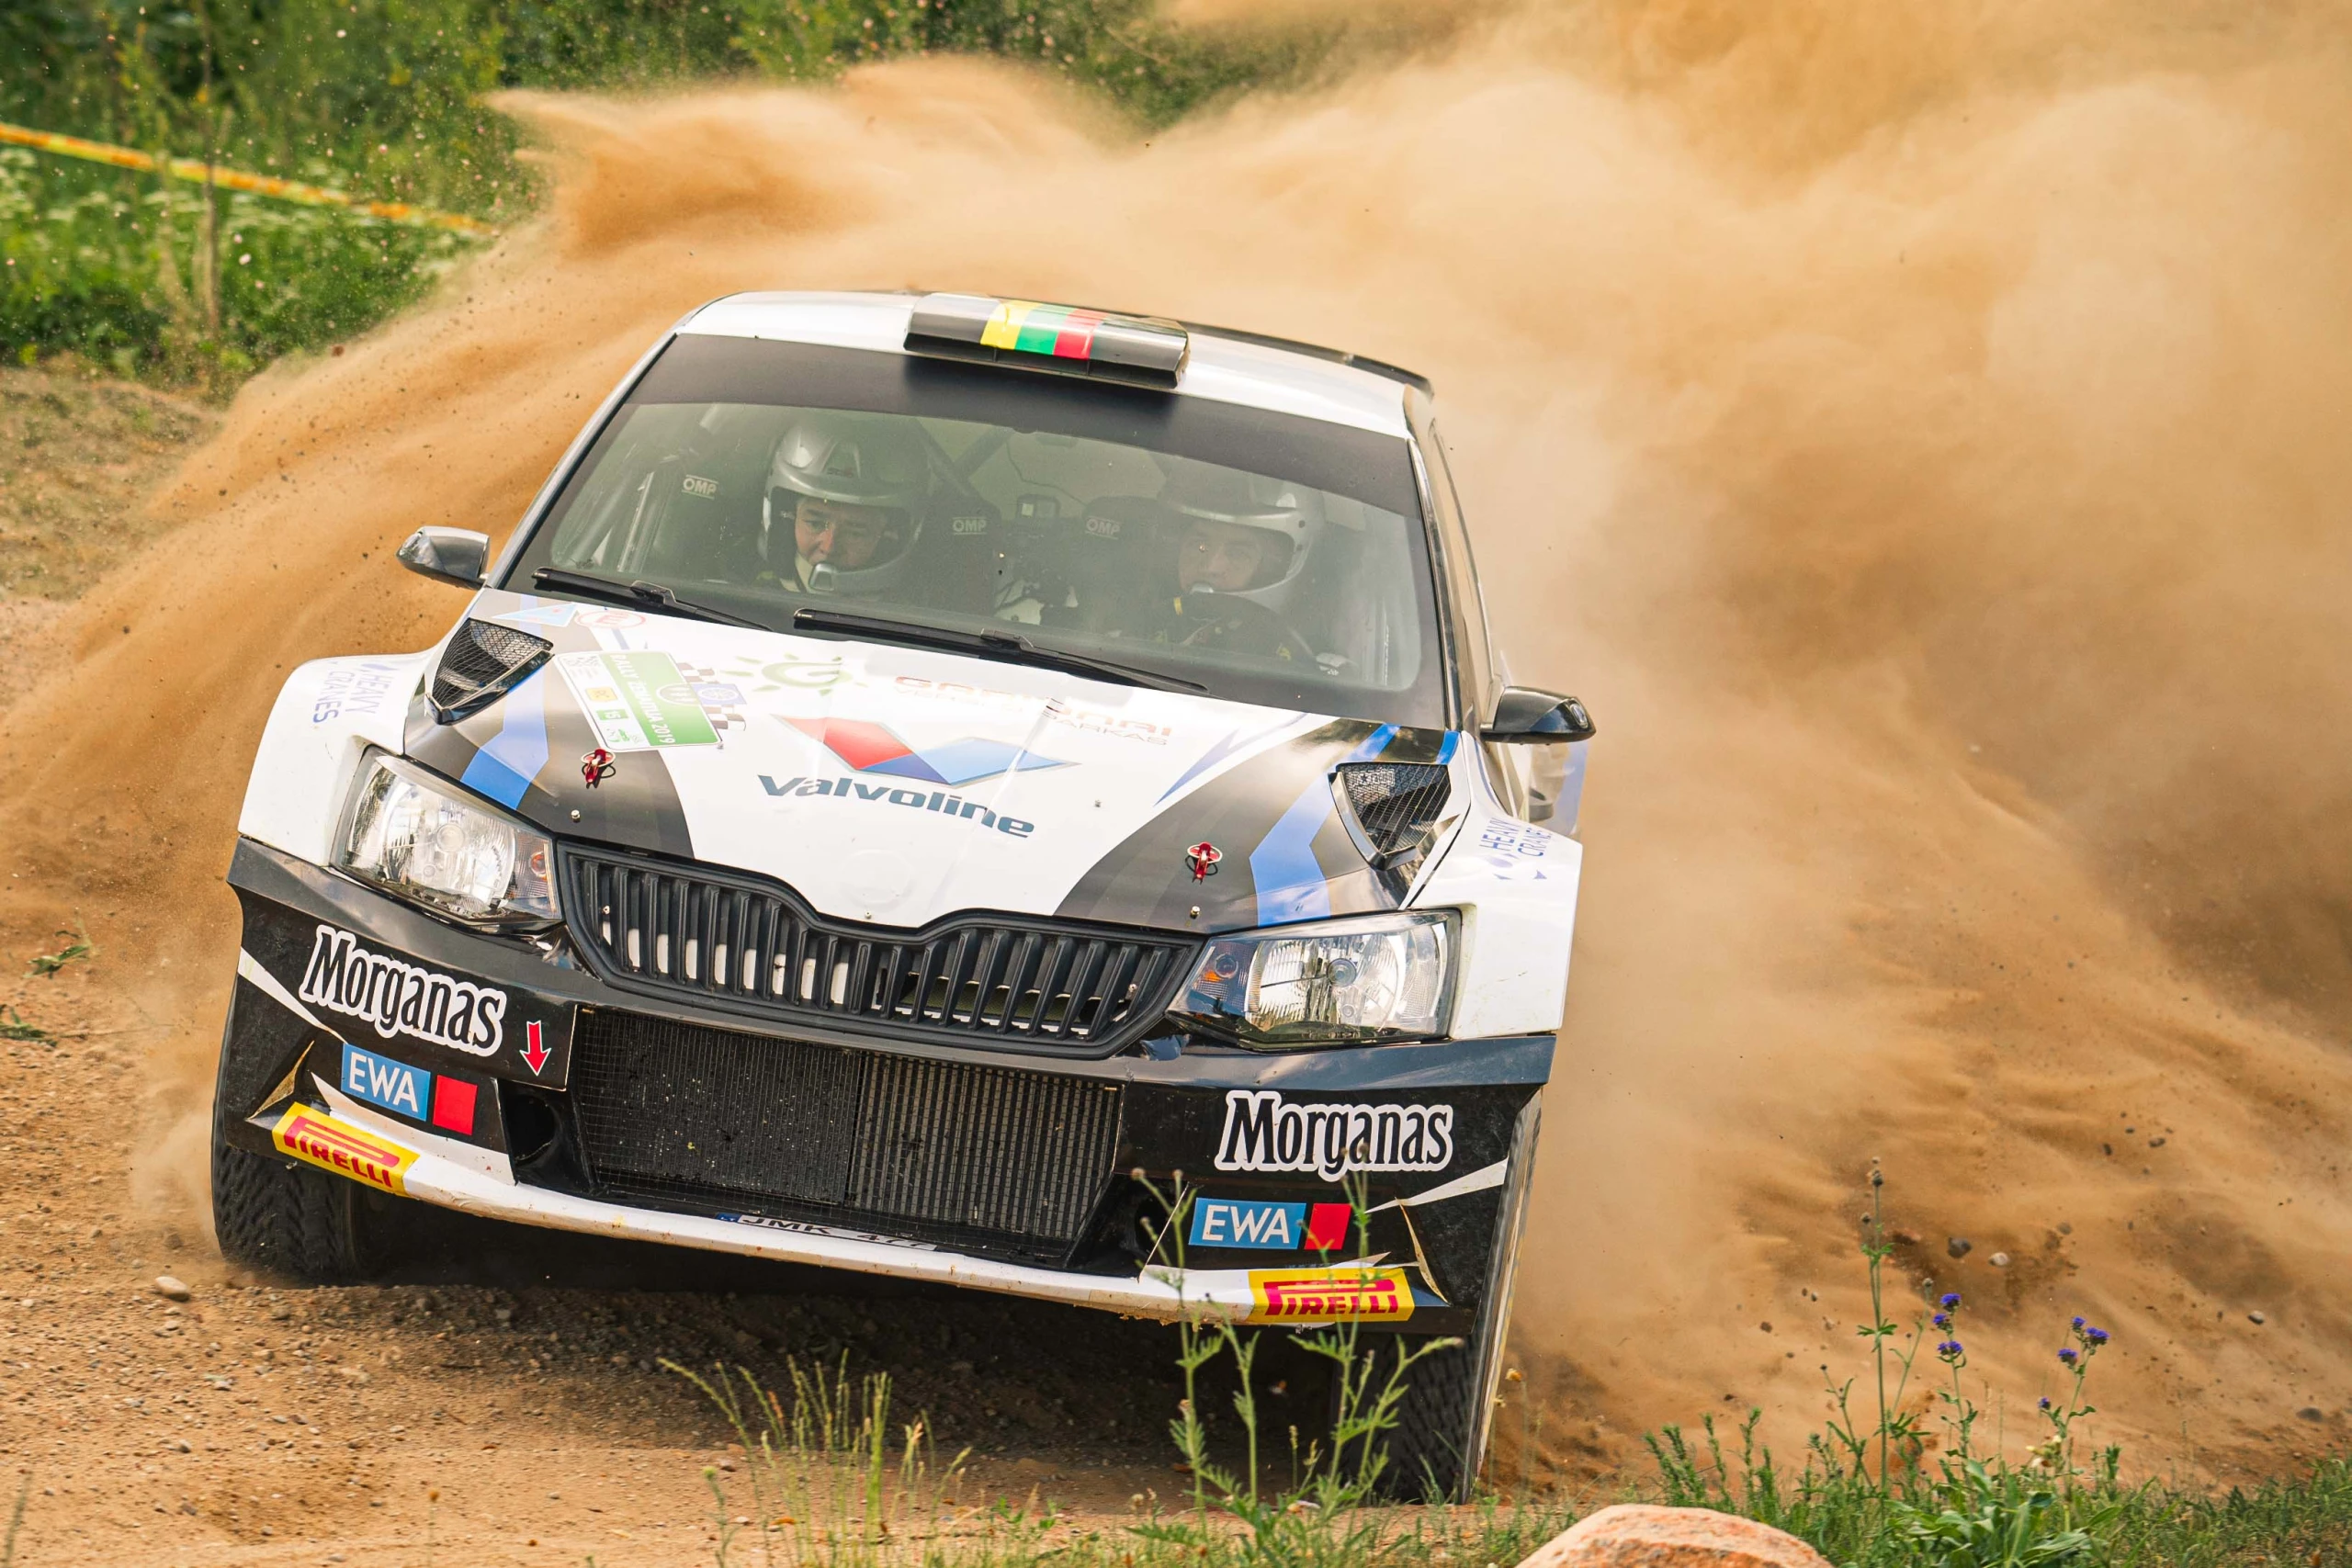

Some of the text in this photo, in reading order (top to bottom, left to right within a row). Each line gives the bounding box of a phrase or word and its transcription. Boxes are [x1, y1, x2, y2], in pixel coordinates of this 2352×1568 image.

[684, 477, 717, 495] OMP
[953, 519, 987, 533] OMP
[1086, 518, 1121, 536] OMP
[312, 671, 356, 724] CRANES
[345, 673, 394, 715] HEAVY
[651, 721, 675, 744] 2019
[757, 774, 1035, 839] Valvoline
[300, 927, 503, 1054] Morganas
[348, 1052, 419, 1113] EWA
[283, 1115, 401, 1189] PIRELLI
[1217, 1093, 1452, 1179] Morganas
[741, 1218, 831, 1235] JMK
[1202, 1204, 1290, 1244] EWA
[1262, 1278, 1399, 1316] PIRELLI
